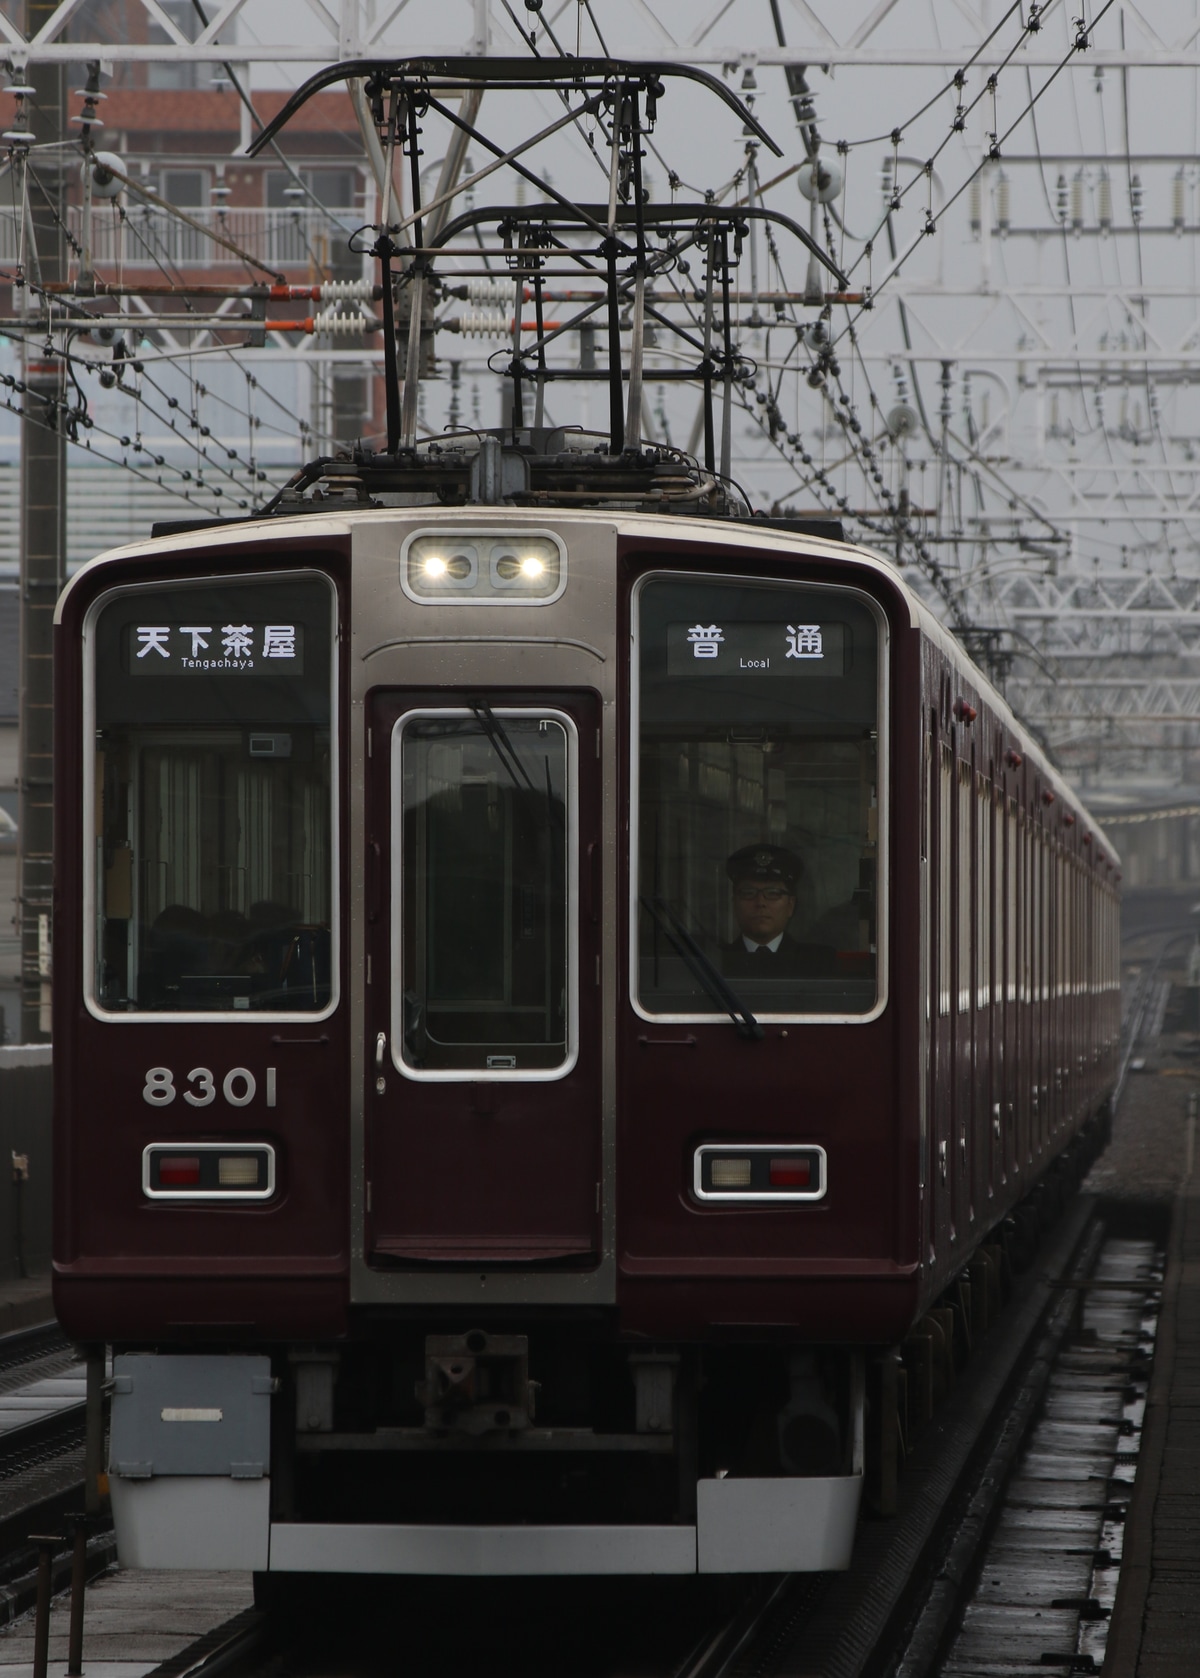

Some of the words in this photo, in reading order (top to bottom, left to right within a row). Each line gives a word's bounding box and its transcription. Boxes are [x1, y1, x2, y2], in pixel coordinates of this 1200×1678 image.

[136, 624, 296, 658] 天下茶屋
[181, 657, 254, 670] Tengachaya
[739, 657, 770, 668] Local
[142, 1067, 277, 1107] 8301
